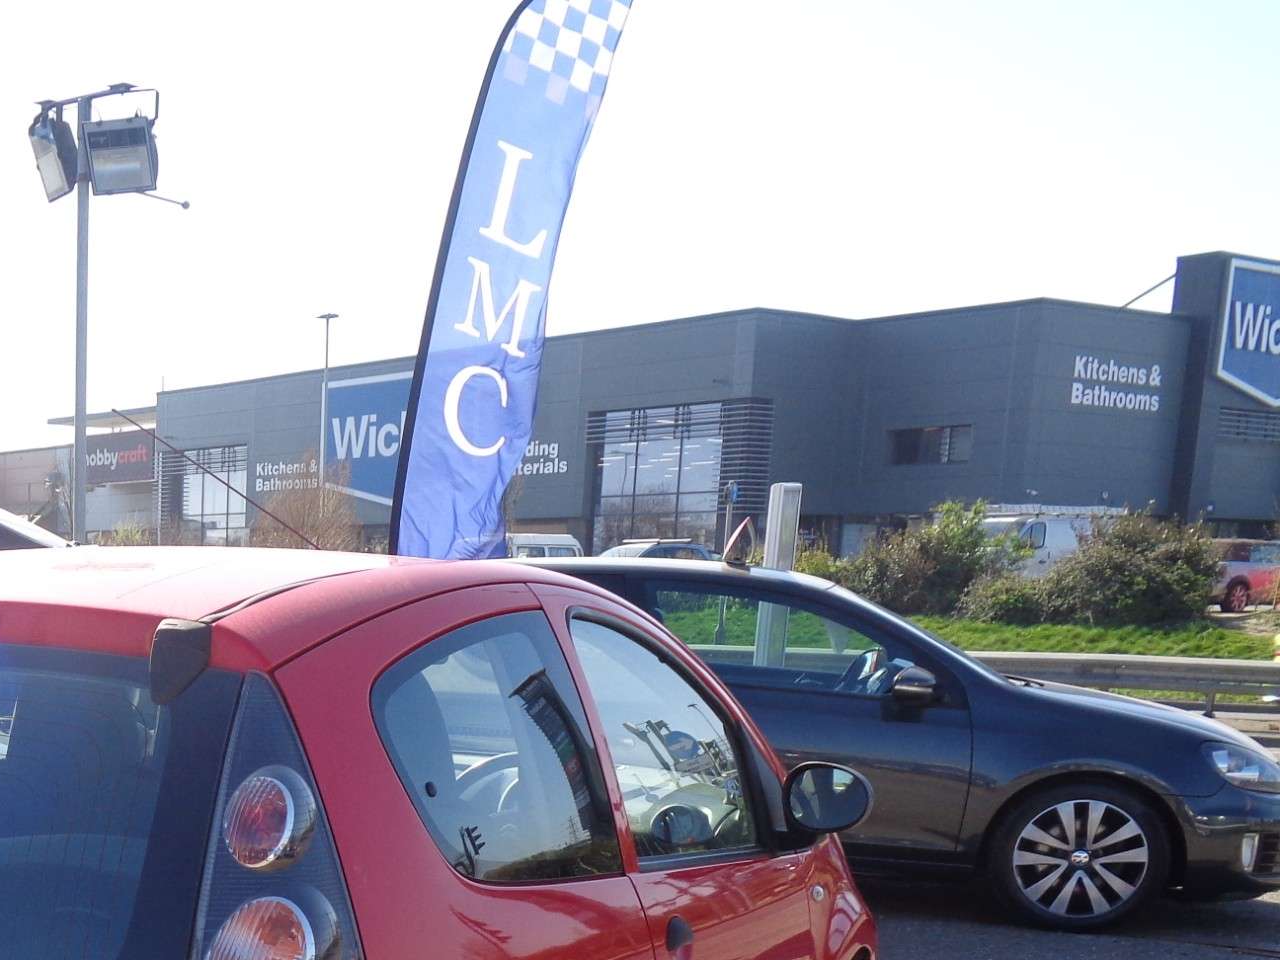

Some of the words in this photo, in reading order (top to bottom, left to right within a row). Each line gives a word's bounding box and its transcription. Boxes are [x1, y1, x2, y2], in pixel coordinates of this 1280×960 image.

[1073, 355, 1148, 386] Kitchens
[1149, 364, 1162, 387] &
[1071, 382, 1160, 412] Bathrooms
[525, 440, 559, 459] ding
